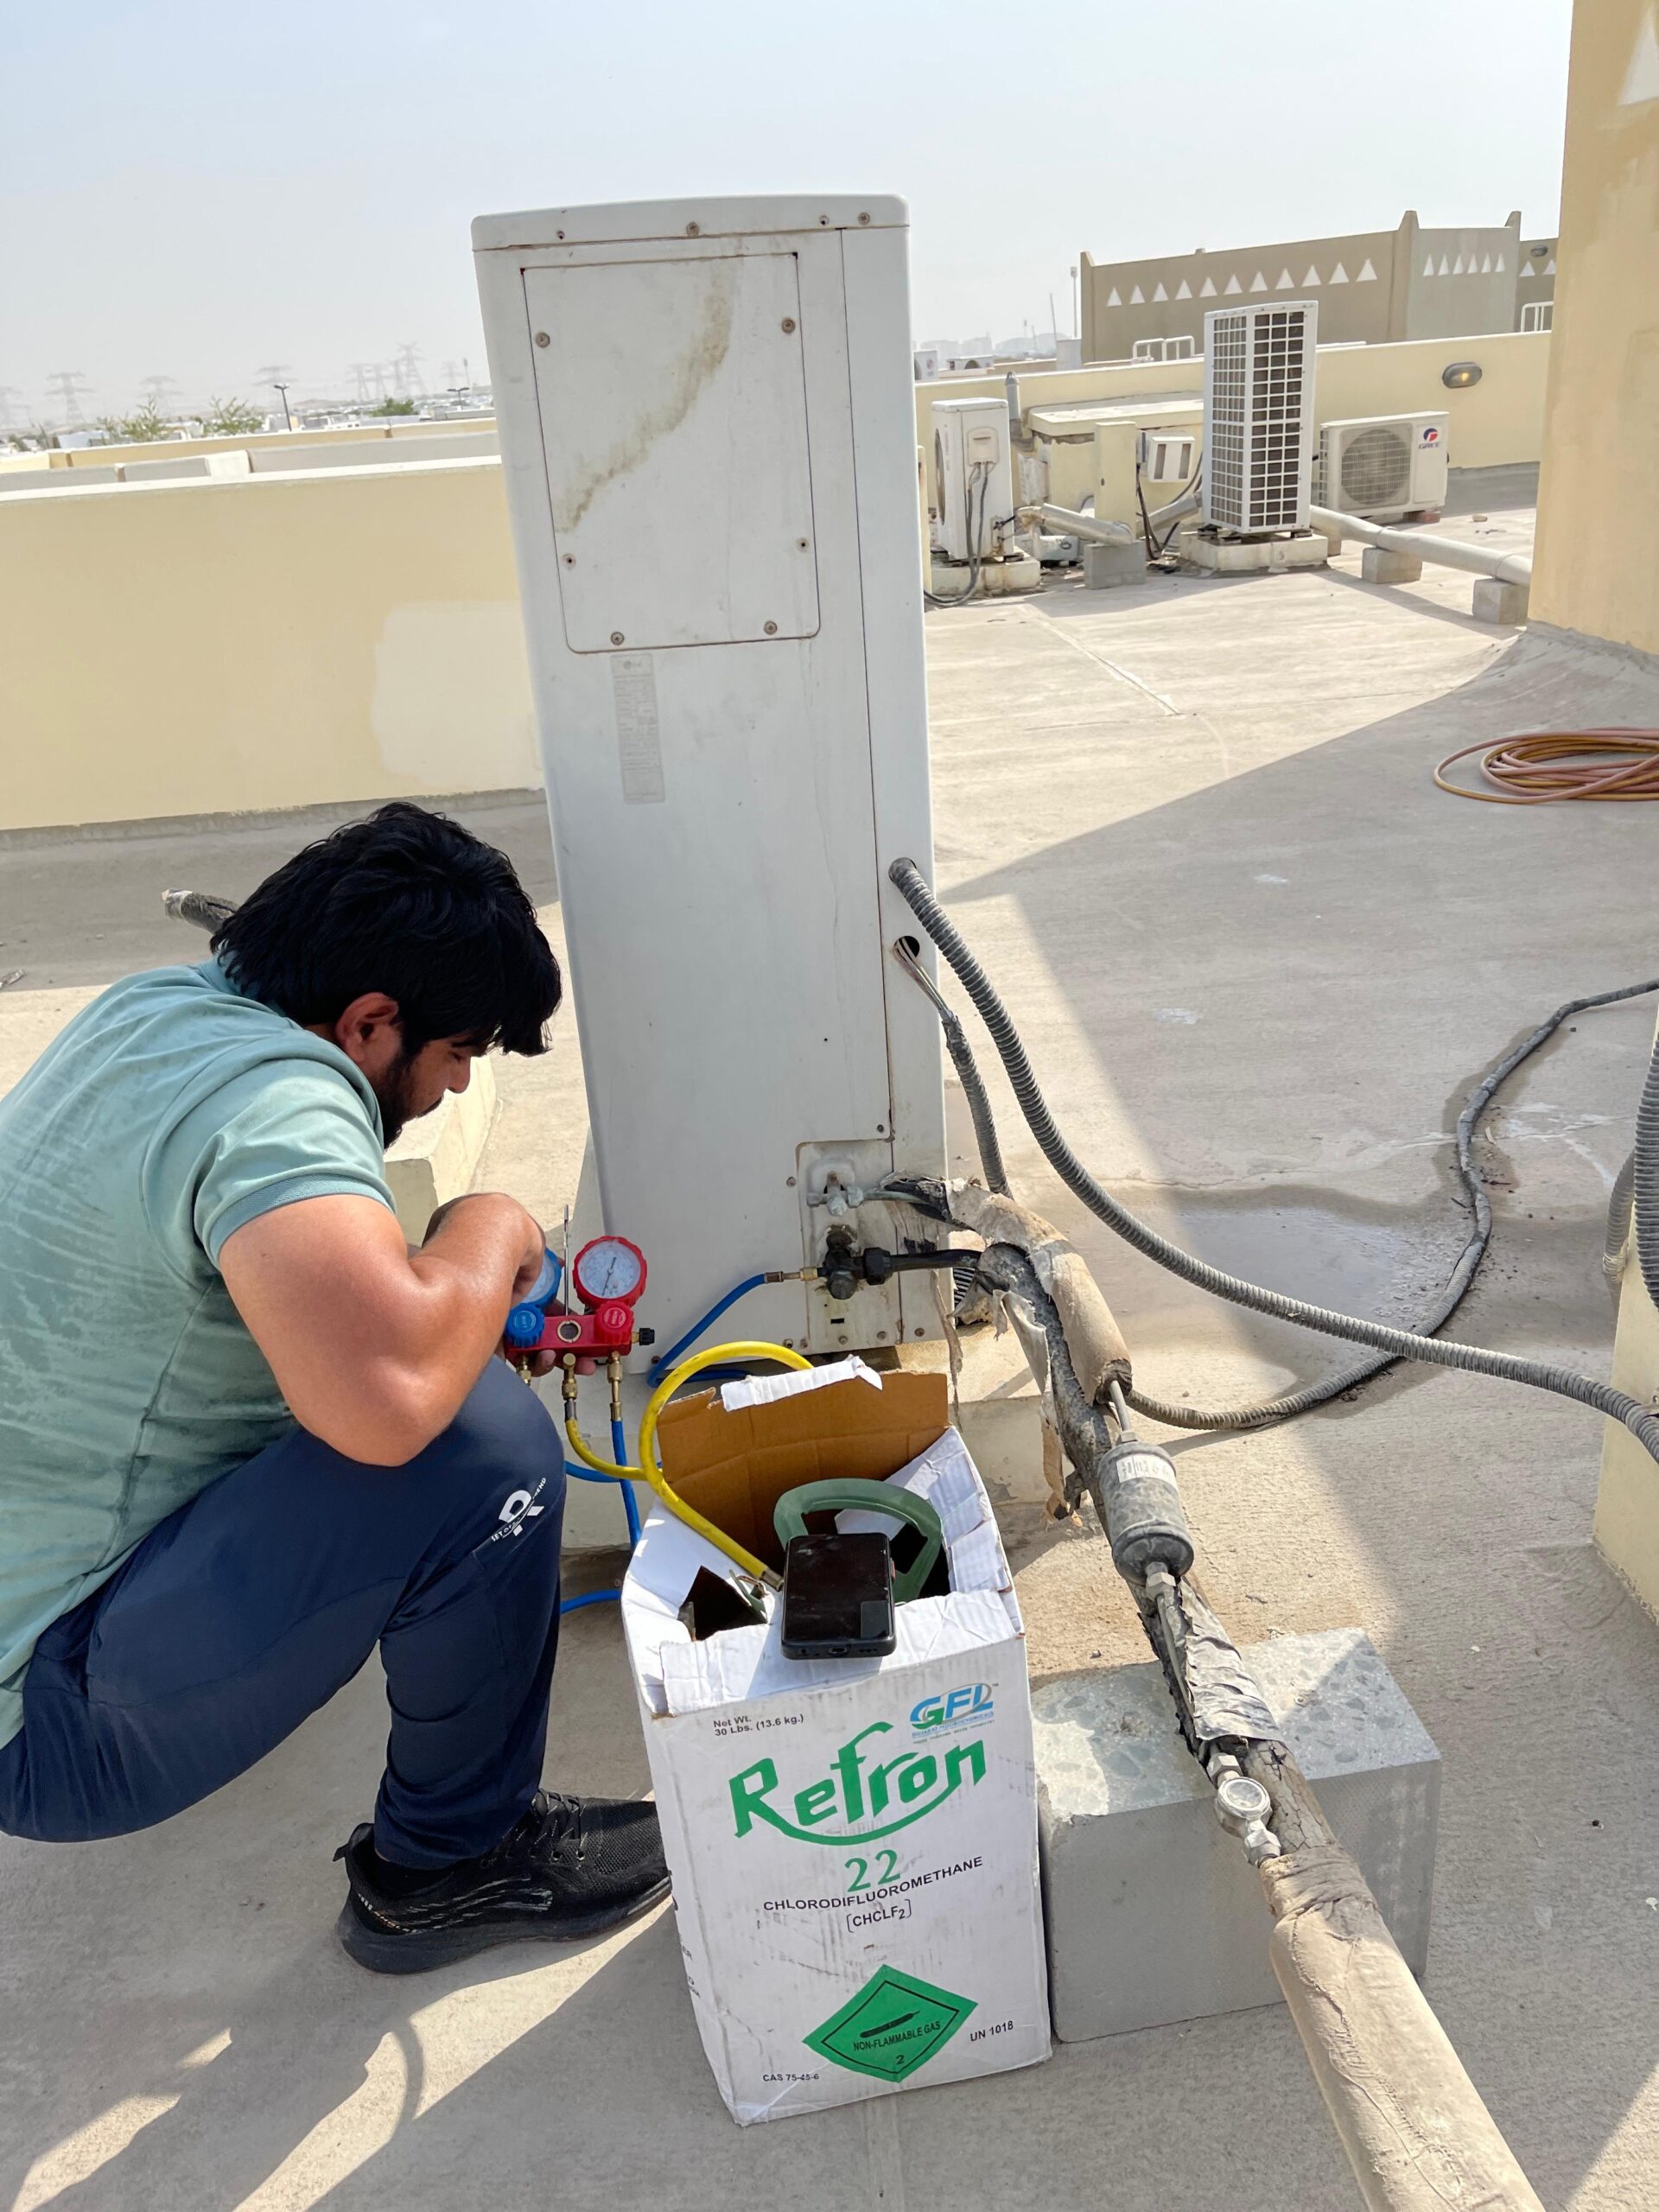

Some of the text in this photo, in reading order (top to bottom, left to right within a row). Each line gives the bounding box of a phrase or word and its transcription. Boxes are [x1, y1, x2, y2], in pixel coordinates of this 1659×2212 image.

[491, 1531, 503, 1542] SET
[910, 1684, 994, 1730] GFL
[713, 1715, 752, 1728] Net Wt.
[715, 1713, 804, 1737] 30 Lbs. (13.6 kg.)
[728, 1721, 986, 1846] Refron
[844, 1848, 900, 1892] 22
[763, 1856, 983, 1910] CHLORODIFLUOROMETHANE
[854, 2020, 941, 2051] NON-FLAMMABLE GAS
[970, 2020, 1014, 2042] UN 1018
[895, 2055, 905, 2065] 2
[763, 2073, 784, 2082] CAS
